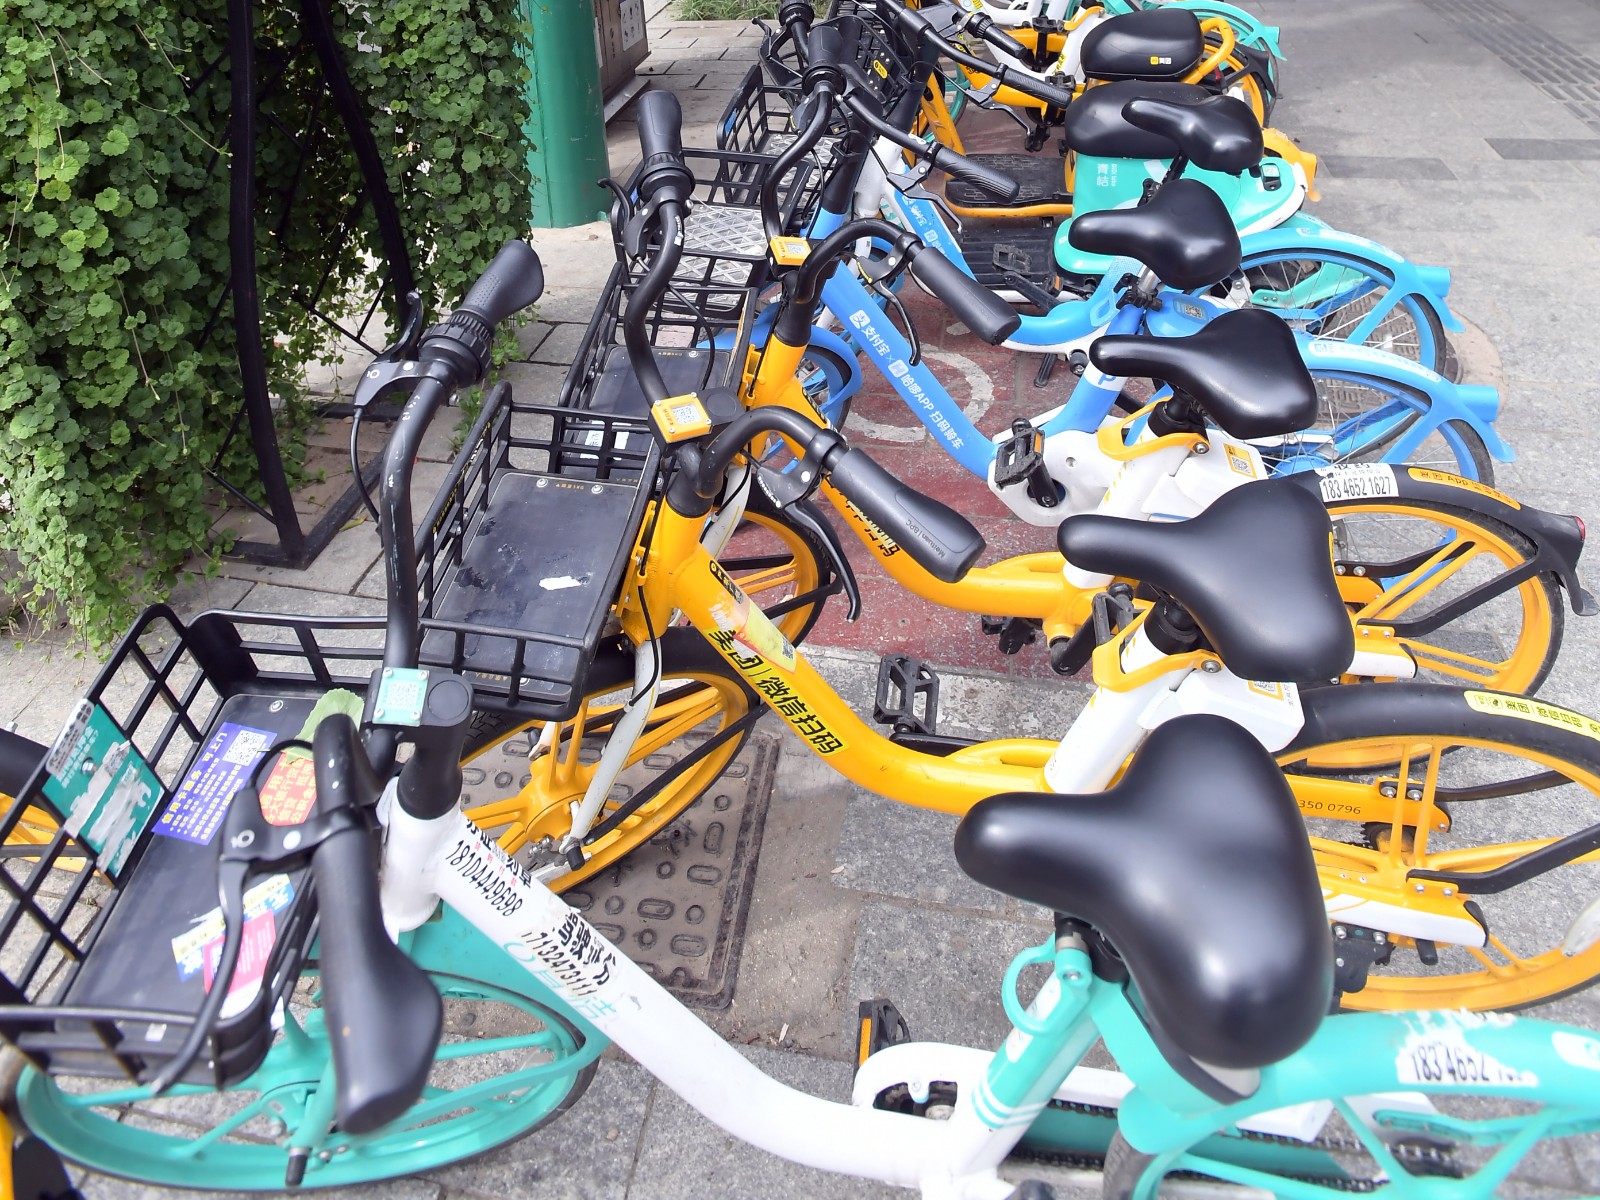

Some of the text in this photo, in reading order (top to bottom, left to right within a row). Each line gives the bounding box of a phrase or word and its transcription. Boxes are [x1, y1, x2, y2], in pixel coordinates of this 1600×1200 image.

[861, 324, 891, 356] 支付宝
[929, 410, 965, 450] 扫码骑车
[1322, 476, 1392, 500] 183 4652 1627
[921, 533, 946, 559] Meituan
[756, 676, 844, 754] 微信扫码
[161, 769, 202, 824] 信用卡服务
[202, 732, 228, 762] 可上门
[1299, 800, 1362, 815] 350 0796
[445, 839, 524, 917] 18104449698
